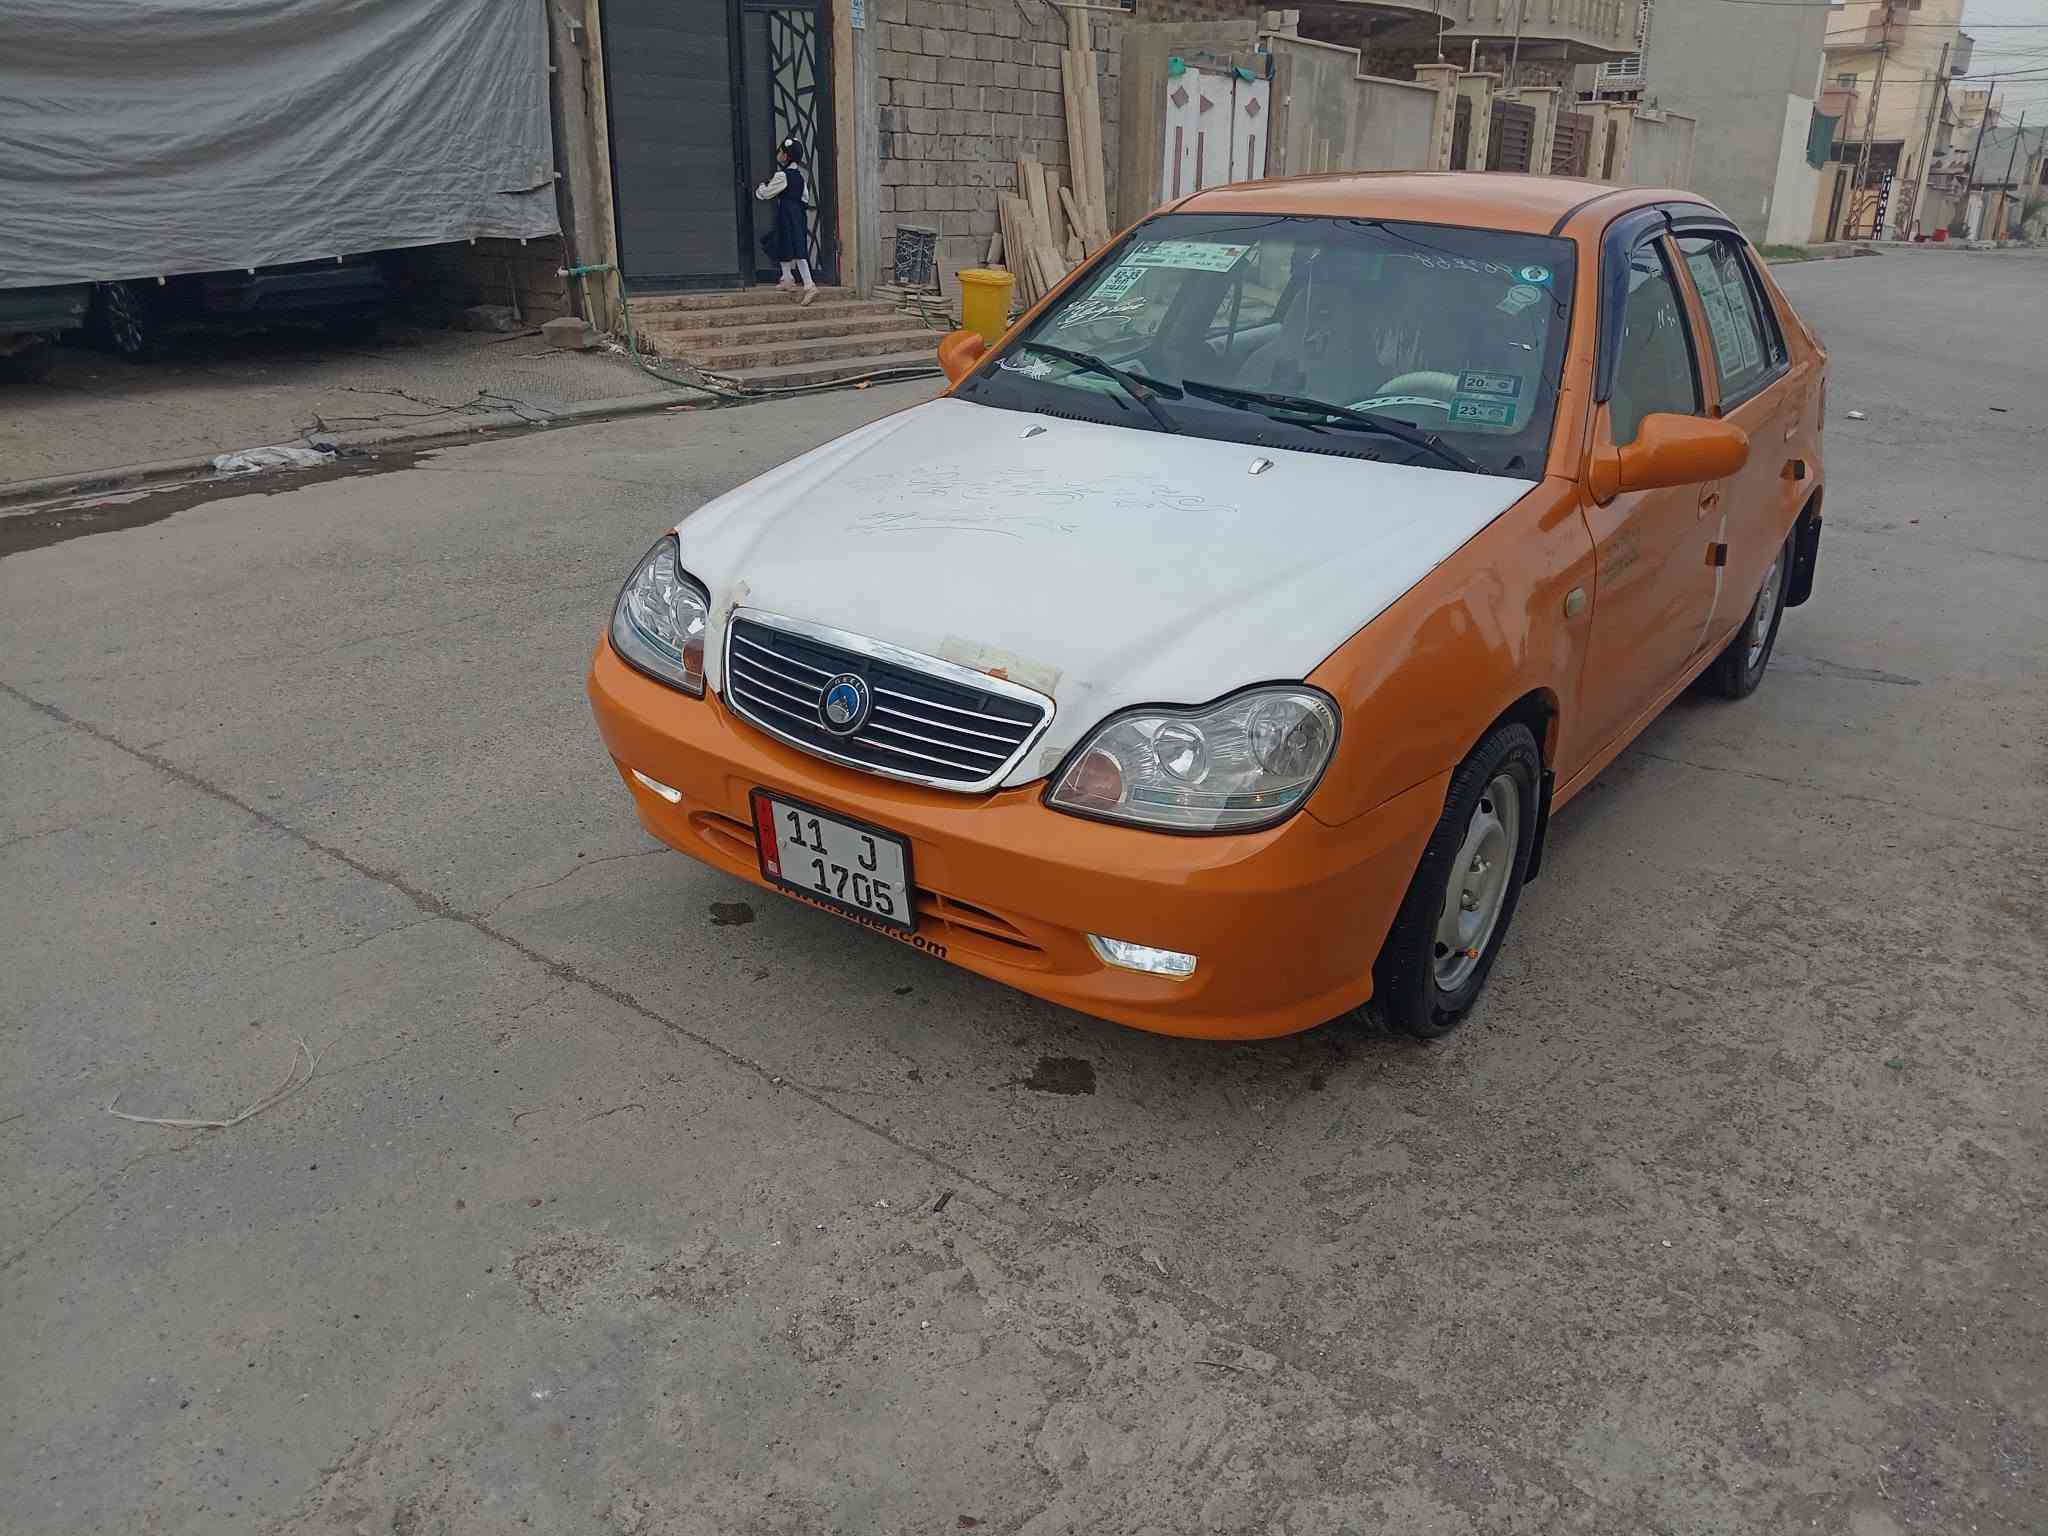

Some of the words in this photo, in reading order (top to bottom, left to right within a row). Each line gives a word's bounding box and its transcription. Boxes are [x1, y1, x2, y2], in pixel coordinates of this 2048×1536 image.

[786, 810, 828, 856] 11
[857, 835, 877, 872] J
[811, 857, 895, 916] 1705
